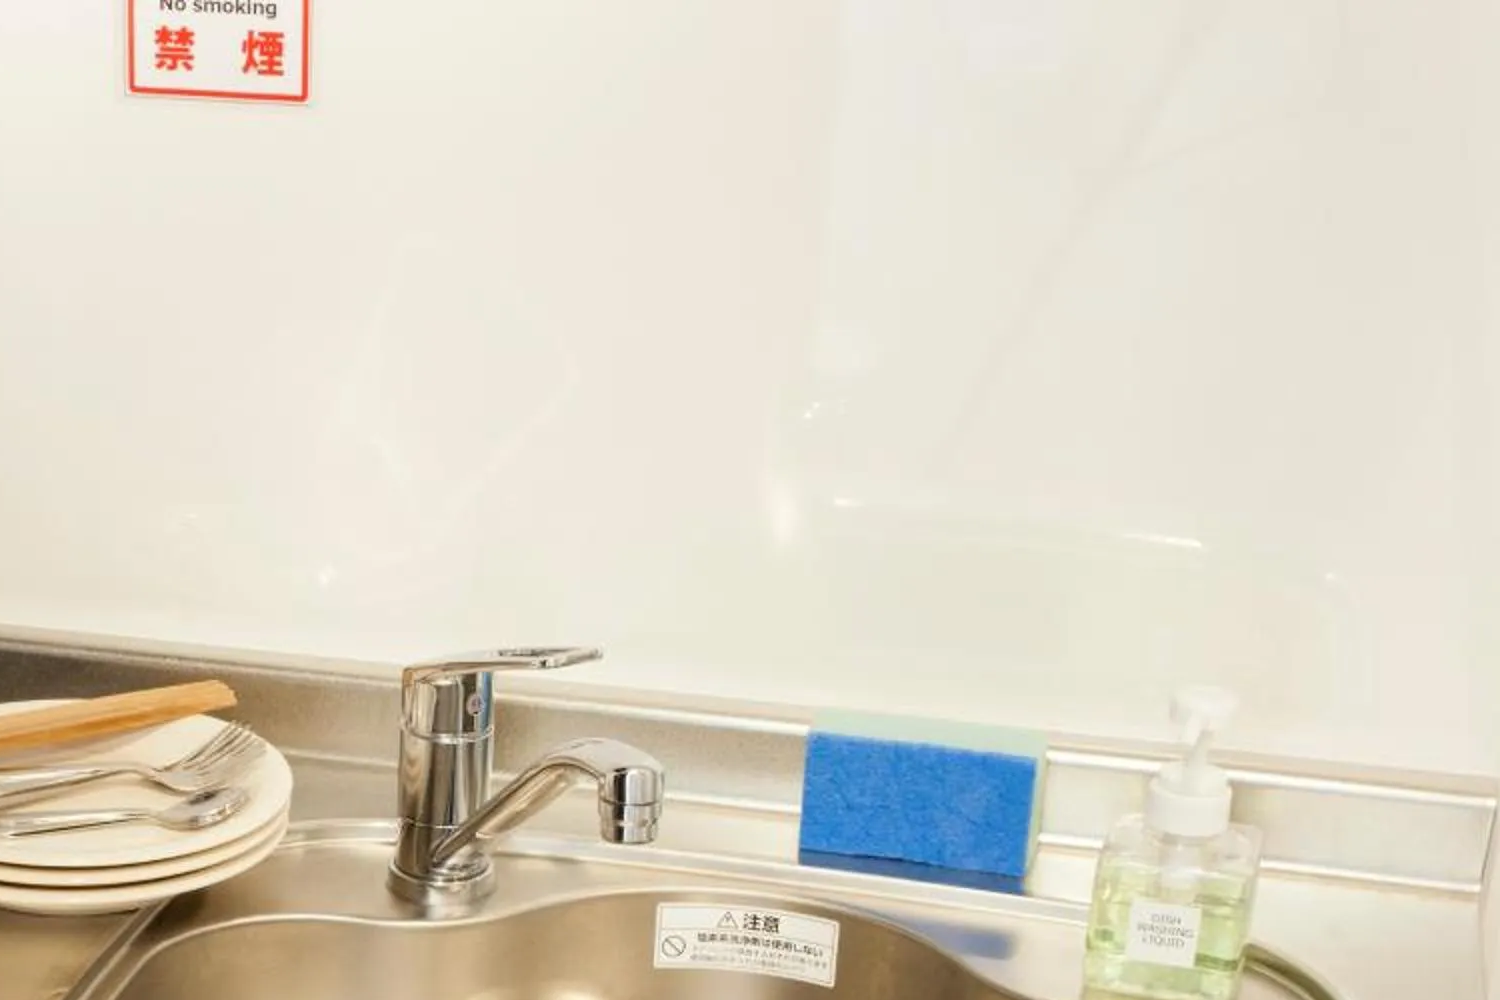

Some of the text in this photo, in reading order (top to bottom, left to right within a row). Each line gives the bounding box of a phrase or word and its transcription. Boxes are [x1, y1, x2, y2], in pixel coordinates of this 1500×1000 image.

[159, 0, 277, 19] No smoking
[743, 912, 781, 934] 注意
[1151, 913, 1182, 925] DISH
[1137, 922, 1194, 939] WASHING
[1141, 934, 1185, 949] LIQUID
